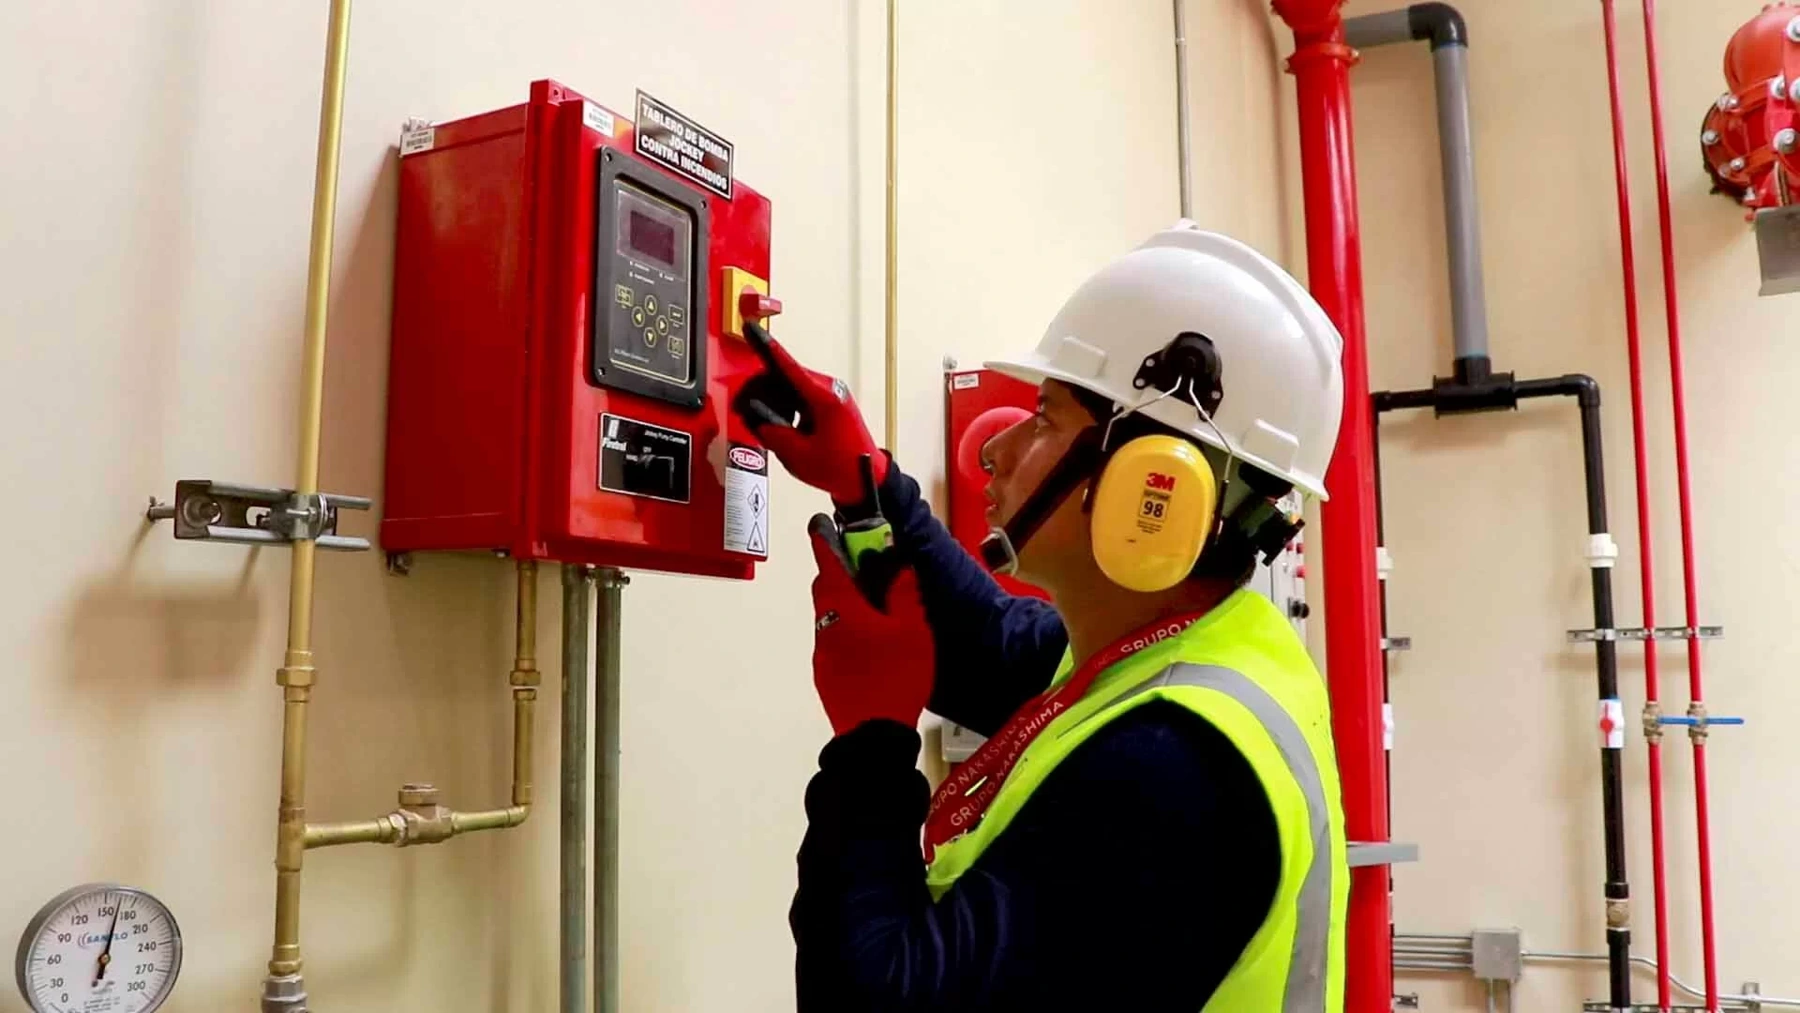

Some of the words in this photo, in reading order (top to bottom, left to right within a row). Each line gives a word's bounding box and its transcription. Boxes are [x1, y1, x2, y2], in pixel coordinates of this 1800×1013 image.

[642, 103, 684, 136] TABLERO
[685, 127, 698, 144] DE
[699, 135, 729, 160] BOMBA
[669, 134, 705, 162] JOCKEY
[641, 134, 680, 165] CONTRA
[680, 155, 727, 190] INCENDIOS
[1146, 472, 1175, 491] 3M
[1143, 500, 1164, 518] 98
[1120, 623, 1181, 653] GRUPO
[950, 781, 996, 826] GRUPO
[996, 701, 1064, 779] NAKASHIMA
[931, 782, 957, 813] UPO
[97, 906, 115, 918] 150
[120, 910, 137, 921] 180
[71, 914, 89, 926] 120
[133, 923, 149, 935] 210
[58, 932, 71, 943] 90
[86, 932, 128, 944] SANLO
[138, 941, 157, 953] 240
[47, 954, 62, 965] 60
[135, 963, 154, 975] 270
[50, 977, 64, 988] 30
[127, 981, 146, 992] 300
[61, 993, 69, 1003] 0
